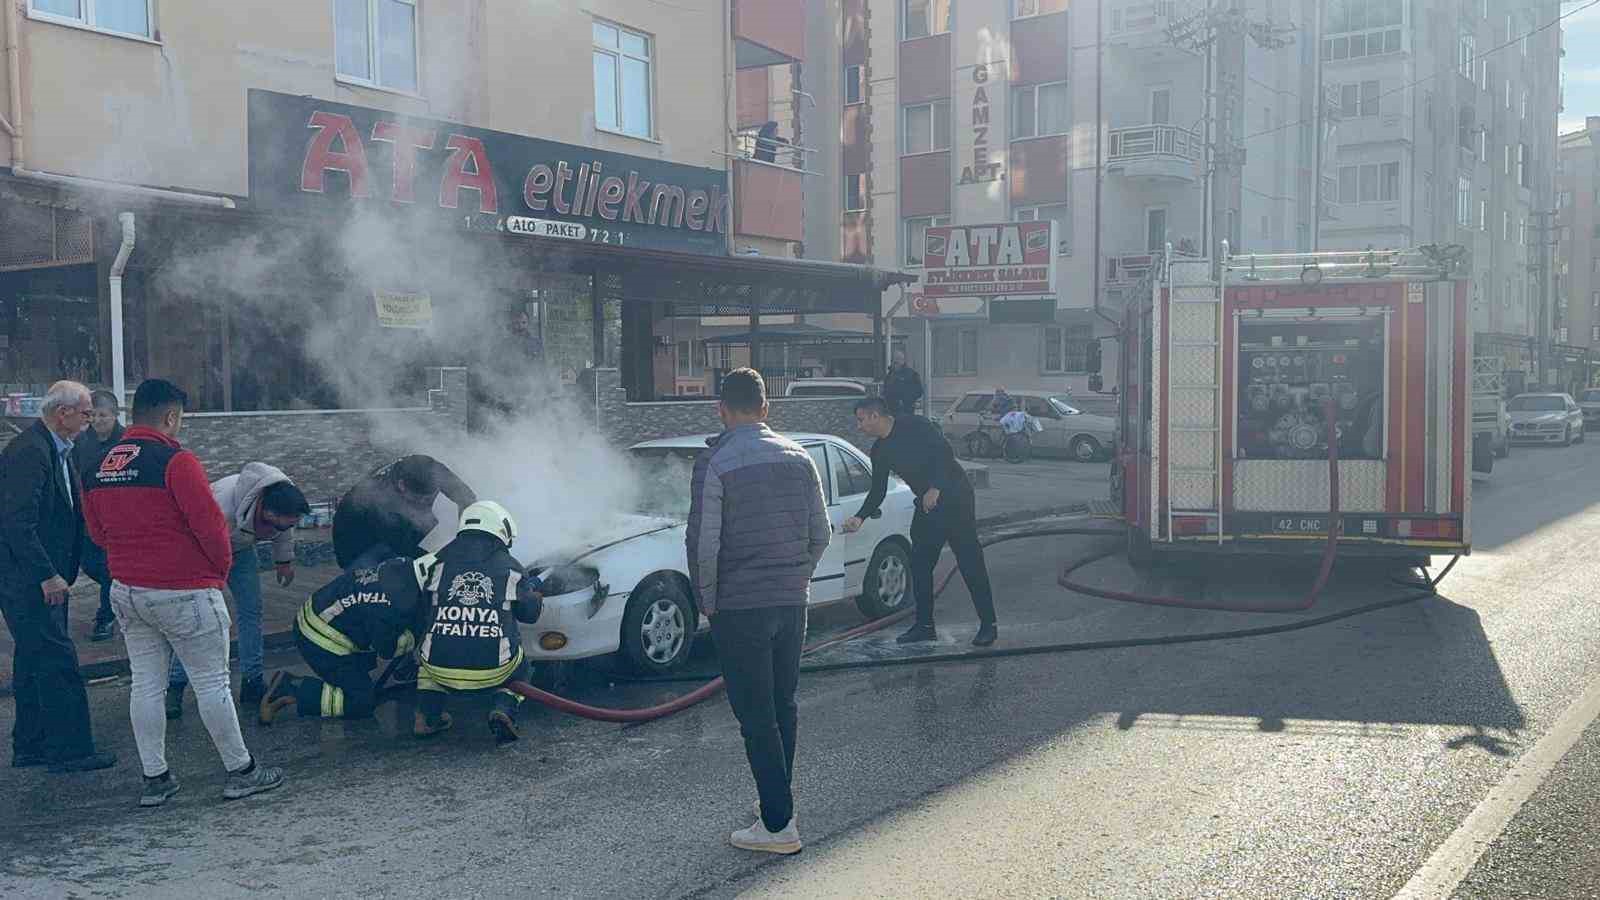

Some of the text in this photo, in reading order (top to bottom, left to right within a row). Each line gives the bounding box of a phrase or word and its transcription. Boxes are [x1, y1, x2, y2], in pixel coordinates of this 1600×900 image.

[972, 63, 989, 164] GAMZE
[301, 110, 730, 233] ATA etliekmek
[512, 219, 536, 232] ALO
[545, 224, 580, 238] PAKET
[945, 225, 1025, 266] ATA
[436, 606, 500, 625] KONYA
